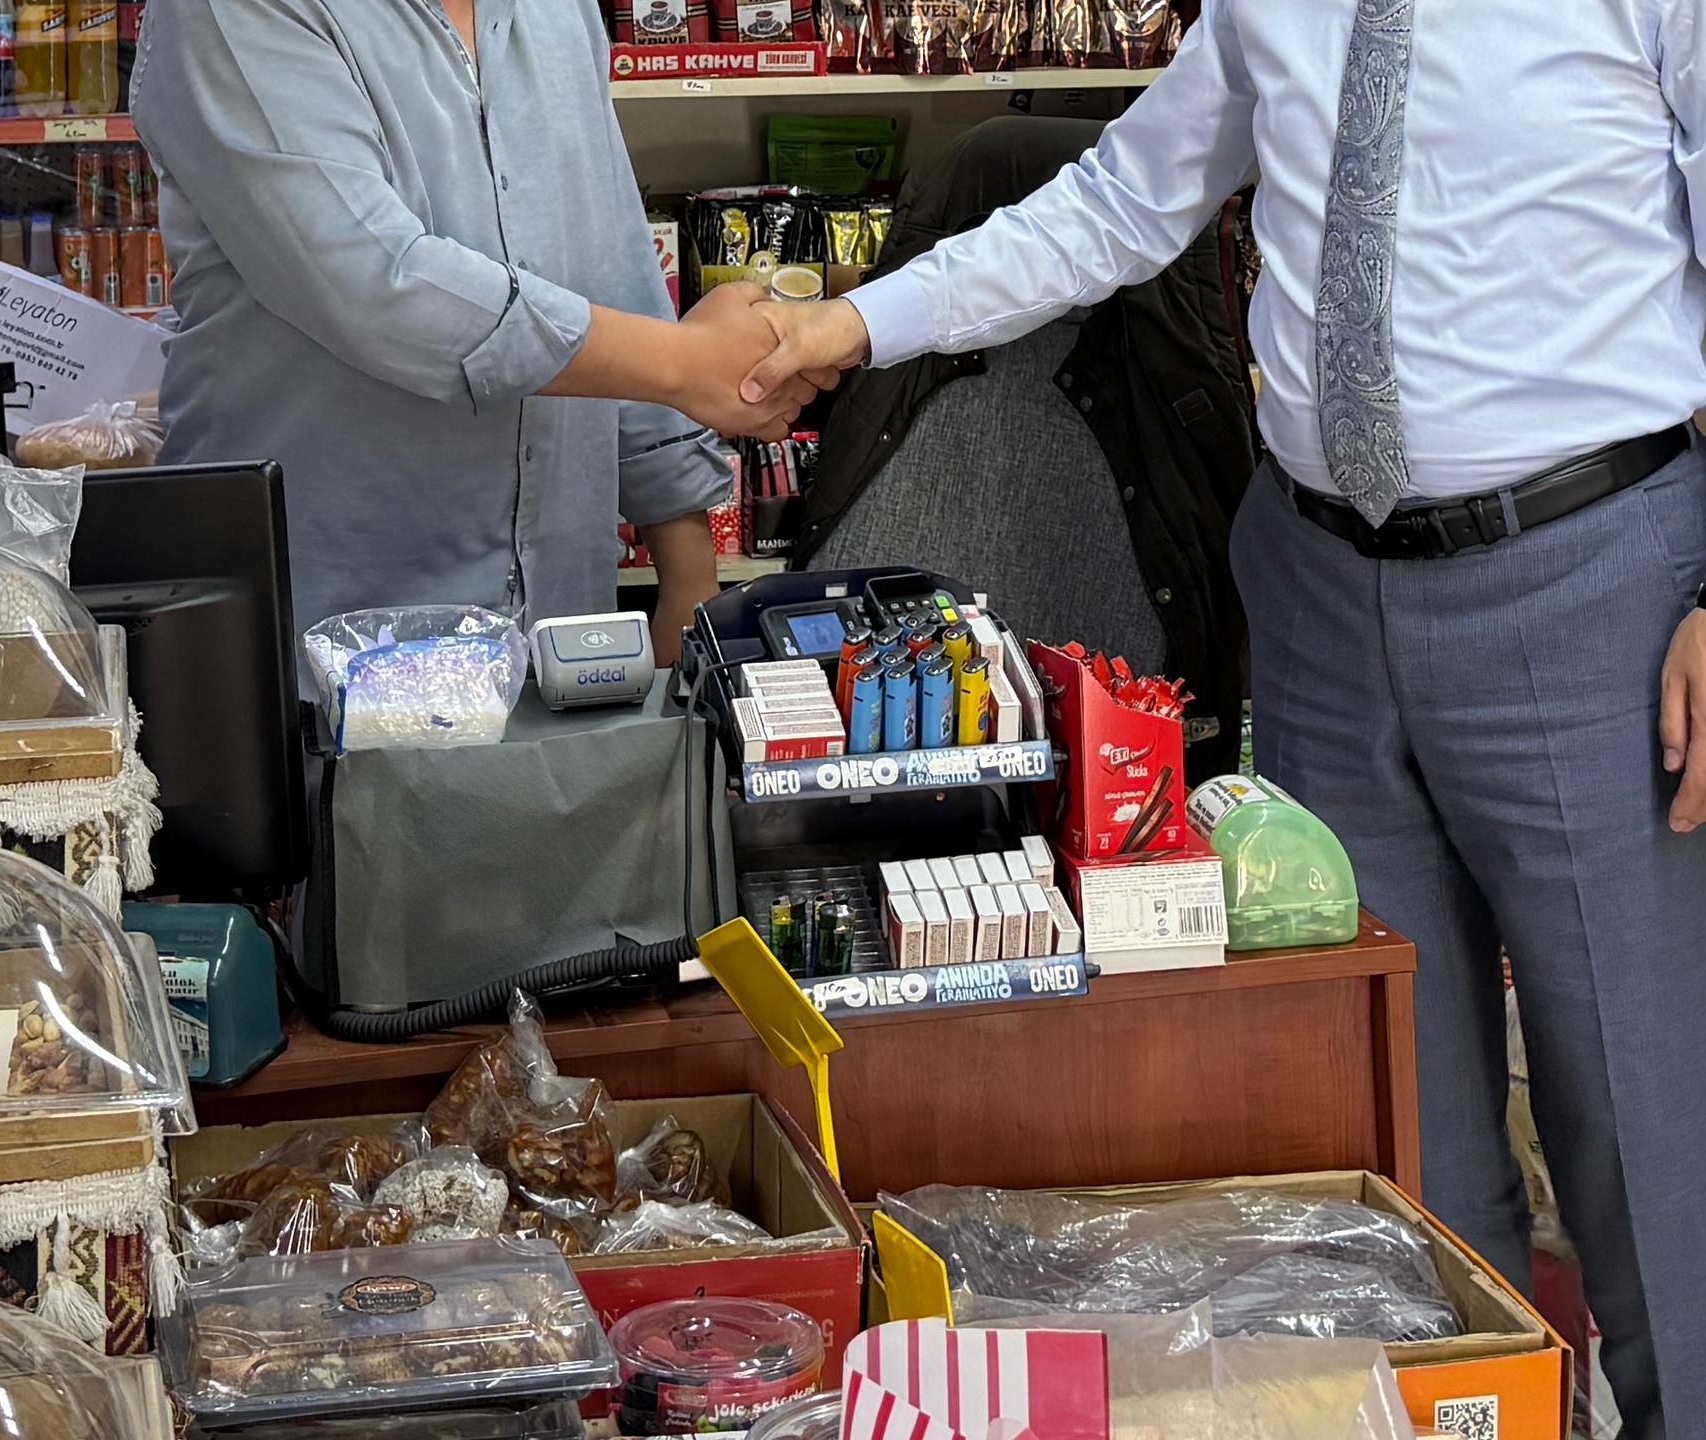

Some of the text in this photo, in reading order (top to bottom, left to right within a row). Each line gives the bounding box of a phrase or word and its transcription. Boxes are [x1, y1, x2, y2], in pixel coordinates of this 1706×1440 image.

[885, 1, 958, 18] KAHVESİ
[637, 56, 678, 71] HAS
[686, 55, 754, 70] KAHVE
[0, 288, 78, 332] Leyaton
[752, 757, 899, 796] ONEO ONEO
[935, 964, 1078, 992] ANINDA ONEO
